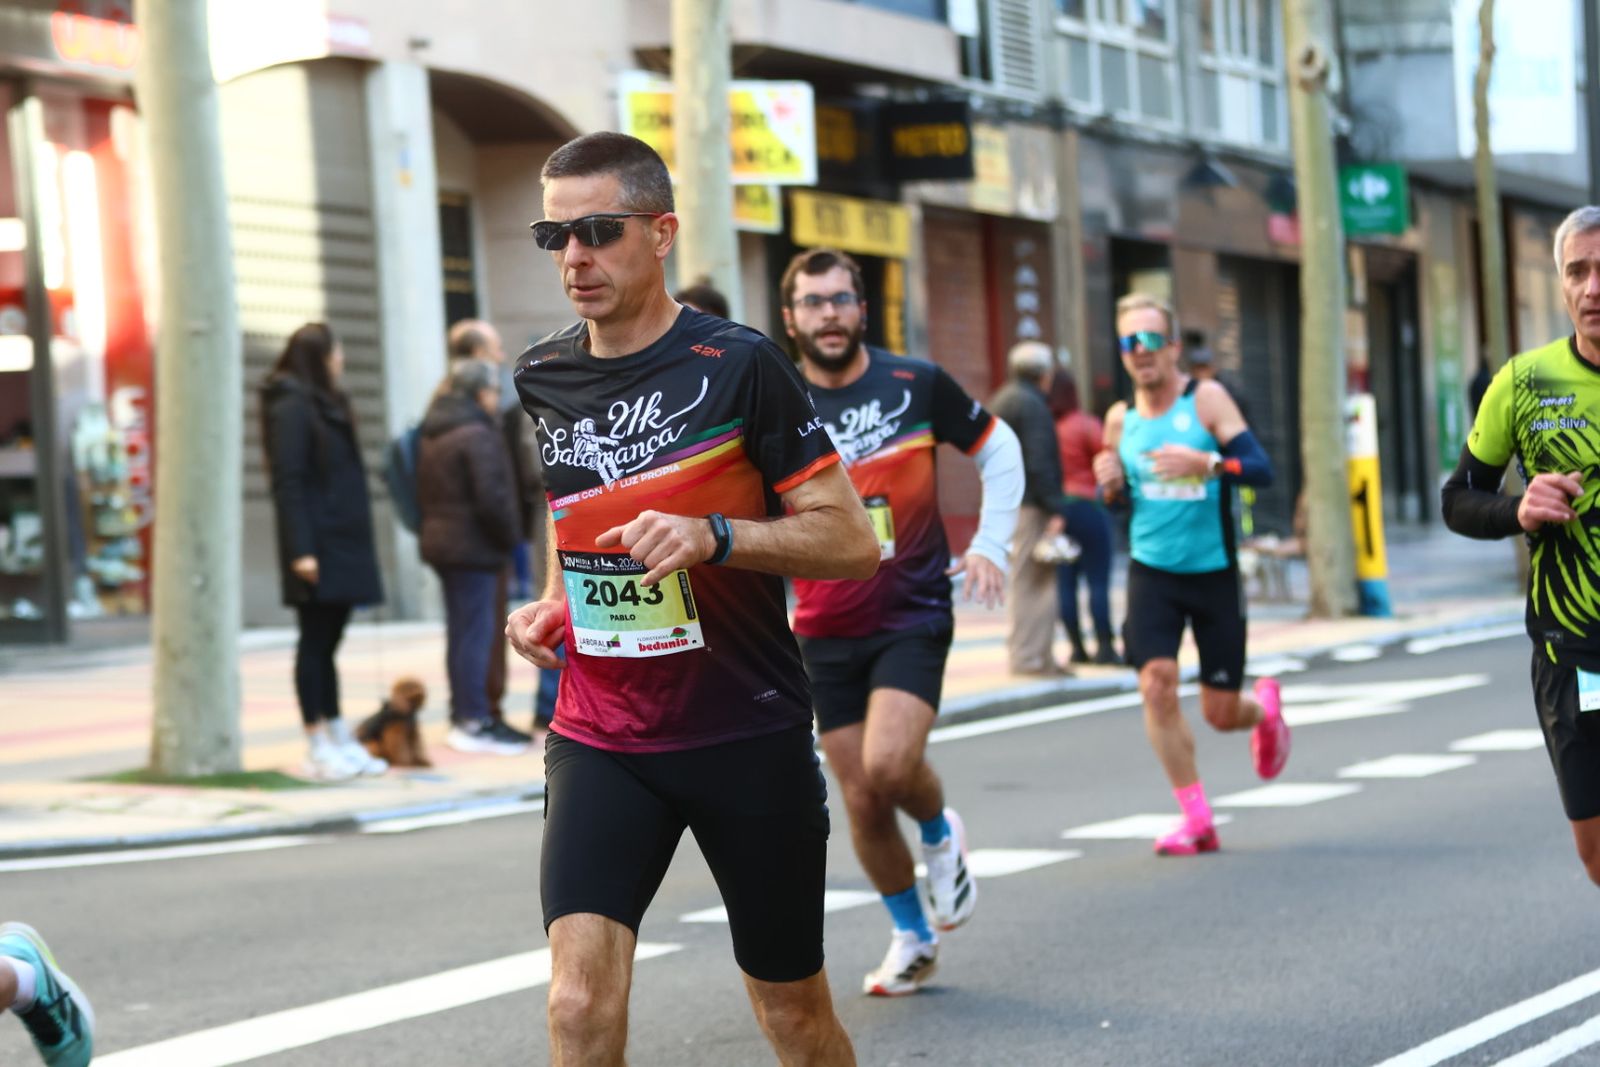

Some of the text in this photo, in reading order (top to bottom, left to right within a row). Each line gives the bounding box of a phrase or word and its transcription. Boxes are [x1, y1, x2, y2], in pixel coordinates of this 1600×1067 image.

[690, 344, 727, 358] 42K
[1530, 417, 1587, 432] João Silva
[536, 417, 688, 474] Salamanca
[555, 464, 681, 508] CORRE CON LUZ PROPIA
[583, 578, 664, 607] 2043
[609, 613, 637, 622] PABLO
[579, 637, 607, 648] LABORAL
